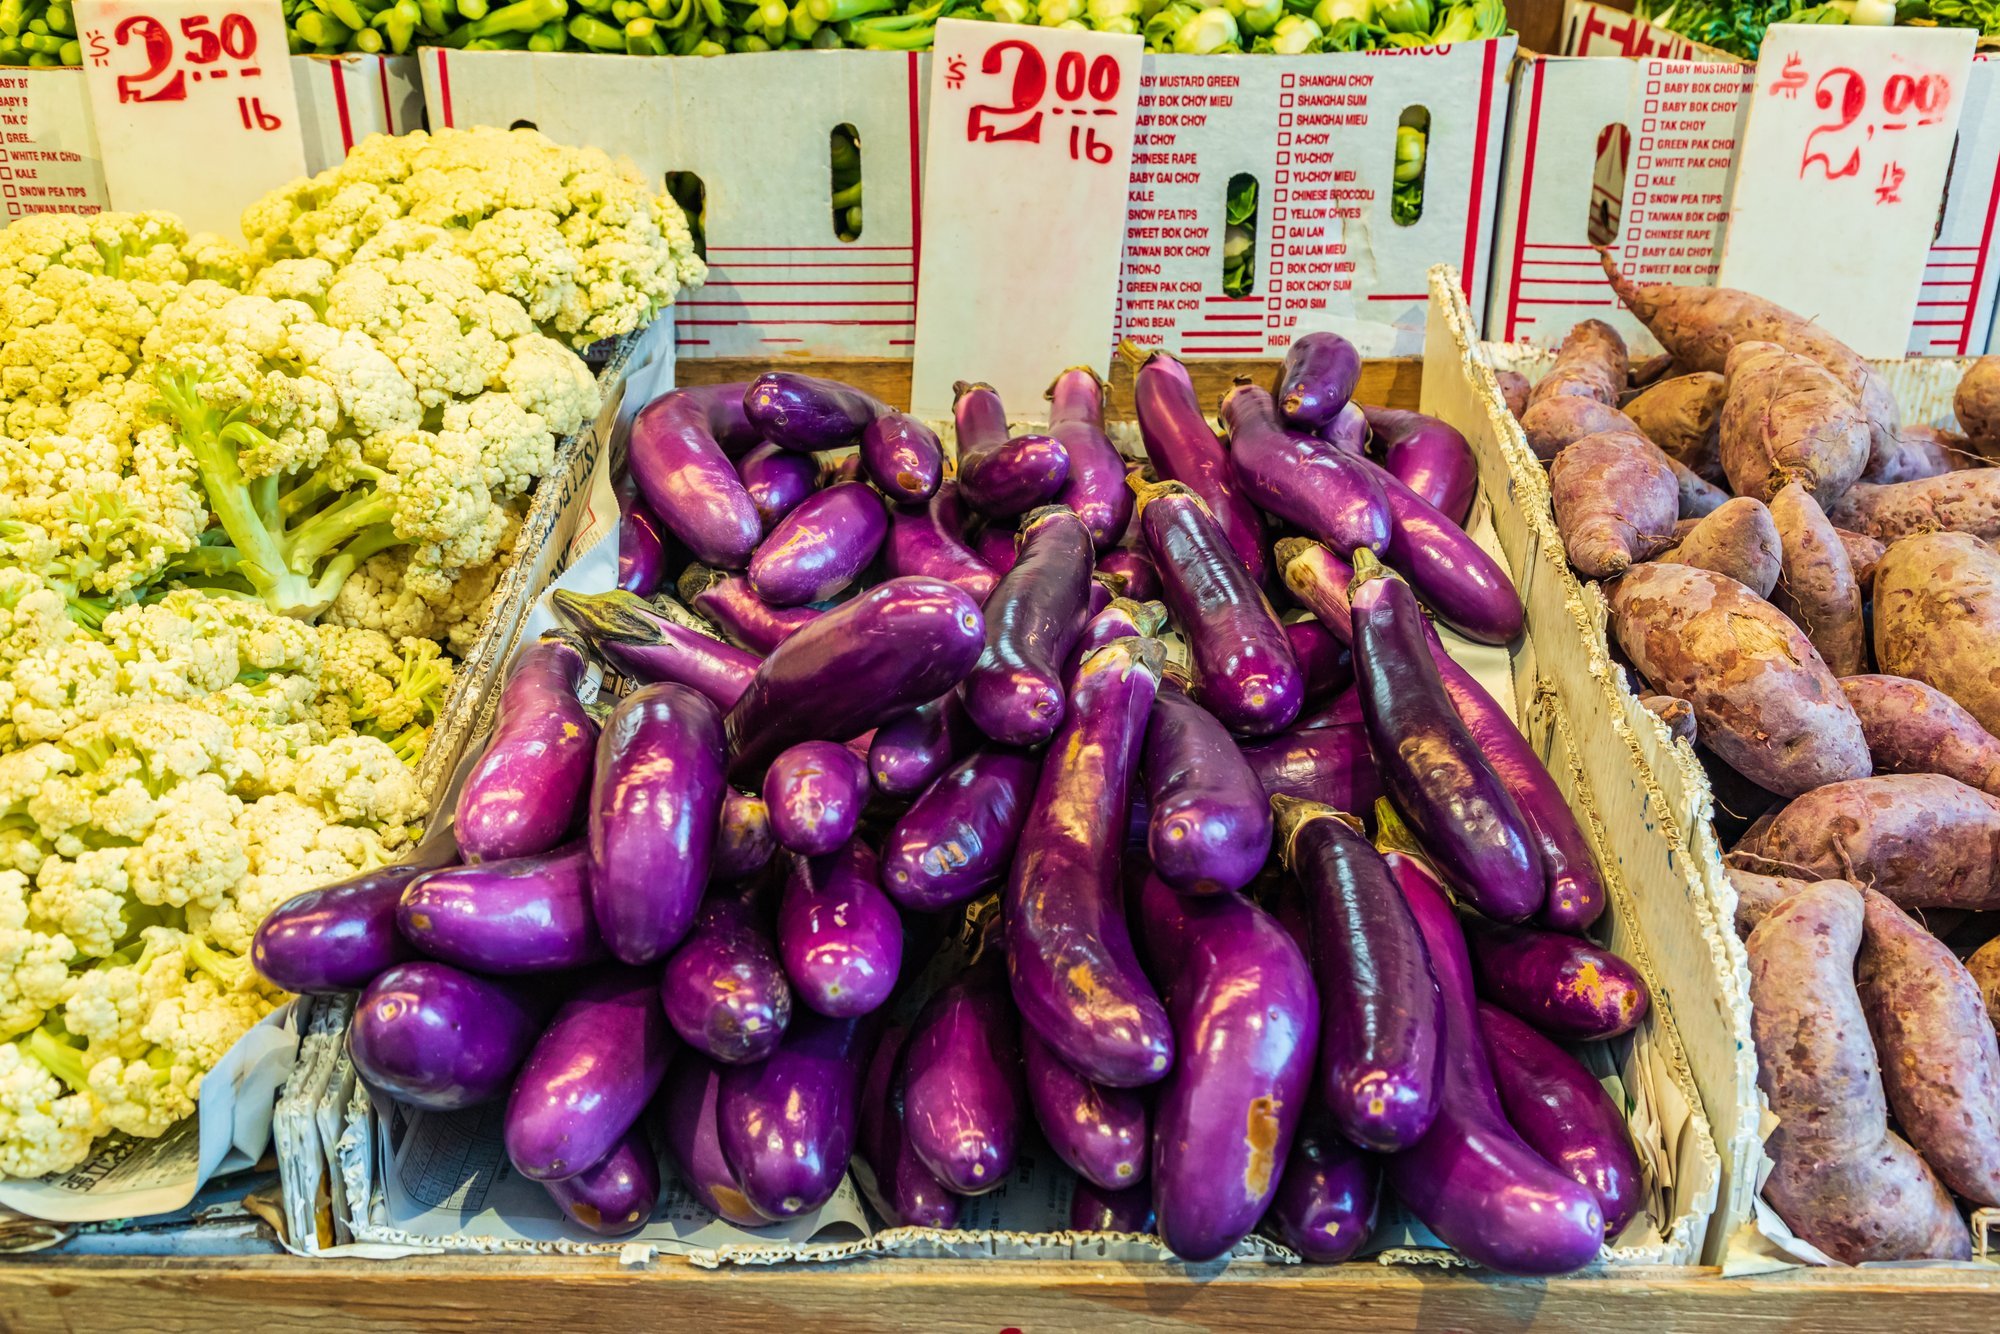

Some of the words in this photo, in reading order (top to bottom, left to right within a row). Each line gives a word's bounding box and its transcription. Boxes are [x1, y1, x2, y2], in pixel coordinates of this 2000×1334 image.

[1667, 65, 1690, 73] BABY
[1694, 64, 1740, 74] MUSTARD
[0, 79, 15, 89] ABY
[1140, 76, 1157, 87] ABY
[1160, 76, 1204, 87] MUSTARD
[1207, 76, 1239, 87] GREEN
[1299, 75, 1346, 87] SHANGHAI
[1349, 75, 1373, 86] CHOY
[1664, 83, 1688, 93] BABY
[1692, 83, 1711, 93] BOK
[1714, 83, 1740, 93] CHOY
[1138, 96, 1157, 107] ABY
[1159, 95, 1179, 107] BOK
[1182, 95, 1207, 106] CHOY
[1210, 96, 1232, 107] MIEU
[1298, 95, 1345, 106] SHANGHAI
[1347, 95, 1367, 106] SUM
[1662, 102, 1687, 112] BABY
[1690, 102, 1709, 112] BOK
[1711, 102, 1737, 112] CHOY
[1, 115, 19, 125] TAK
[1136, 115, 1156, 126] ABY
[1158, 115, 1178, 126] BOK
[1181, 115, 1206, 126] CHOY
[1297, 114, 1343, 126] SHANGHAI
[1346, 114, 1367, 125] MIEU
[1661, 121, 1677, 130] TAK
[1680, 121, 1705, 130] CHOY
[6, 133, 36, 143] GREE
[1134, 135, 1147, 144] AK
[1150, 134, 1175, 145] CHOY
[1295, 134, 1329, 144] A-CHOY
[1657, 139, 1688, 149] GREEN
[1691, 140, 1709, 149] PAK
[1712, 139, 1735, 149] CHOI
[10, 151, 39, 161] WHITE
[40, 152, 57, 161] PAK
[1132, 153, 1169, 164] CHINESE
[1172, 153, 1196, 164] RAPE
[1294, 152, 1333, 164] YU-CHOY
[1656, 158, 1685, 167] WHITE
[1687, 158, 1705, 167] PAK
[1708, 158, 1731, 168] CHOI
[15, 169, 37, 178] KALE
[1129, 172, 1154, 183] BABY
[1156, 173, 1173, 183] GAI
[1175, 172, 1199, 183] CHOY
[1293, 171, 1332, 182] YU-CHOY
[1334, 171, 1356, 181] MIEU
[1652, 176, 1675, 186] KALE
[19, 186, 45, 196] SNOW
[48, 187, 65, 197] PEA
[66, 187, 86, 197] TIPS
[1129, 191, 1154, 202] KALE
[1292, 190, 1328, 201] CHINESE
[1330, 189, 1374, 200] BROCCOLI
[1650, 194, 1679, 203] SNOW
[1681, 194, 1698, 204] PEA
[1702, 194, 1722, 204] TIPS
[23, 204, 57, 213] TAIWAN
[1291, 209, 1326, 219] YELLOW
[1329, 208, 1361, 218] CHIVES
[1128, 209, 1156, 220] SNOW
[1158, 209, 1176, 220] PEA
[1178, 209, 1197, 220] TIPS
[1648, 212, 1683, 221] TAIWAN
[1685, 212, 1704, 222] BOK
[1128, 227, 1160, 238] SWEET
[1162, 227, 1181, 238] BOK
[1184, 228, 1208, 238] CHOY
[1289, 227, 1305, 238] GAI
[1307, 227, 1324, 237] LAN
[1645, 230, 1684, 239] CHINESE
[1686, 230, 1710, 239] RAPE
[1128, 246, 1162, 256] TAIWAN
[1164, 246, 1183, 256] BOK
[1186, 246, 1210, 256] CHOY
[1288, 245, 1304, 256] GAI
[1306, 246, 1323, 255] LAN
[1326, 244, 1346, 254] MIEU
[1642, 248, 1666, 256] BABY
[1669, 248, 1684, 256] GAI
[1687, 247, 1712, 257] CHOY
[1128, 264, 1161, 274] THON-O
[1287, 263, 1306, 273] BOK
[1308, 263, 1332, 273] CHOY
[1335, 262, 1355, 272] MIEU
[1640, 265, 1670, 274] SWEET
[1673, 265, 1692, 274] BOK
[1694, 265, 1719, 274] CHOY
[1127, 282, 1158, 292] GREEN
[1160, 282, 1177, 292] PAK
[1181, 282, 1202, 292] CHOI
[1286, 281, 1305, 291] BOK
[1307, 281, 1331, 291] CHOY
[1333, 280, 1352, 290] SUM
[1126, 300, 1155, 310] WHITE
[1157, 300, 1174, 309] PAK
[1177, 300, 1199, 310] CHOI
[1285, 298, 1308, 309] CHOI
[1310, 298, 1326, 308] SIM
[1126, 318, 1149, 327] LONG
[1153, 317, 1175, 327] BEAN
[1268, 335, 1290, 346] HIGH
